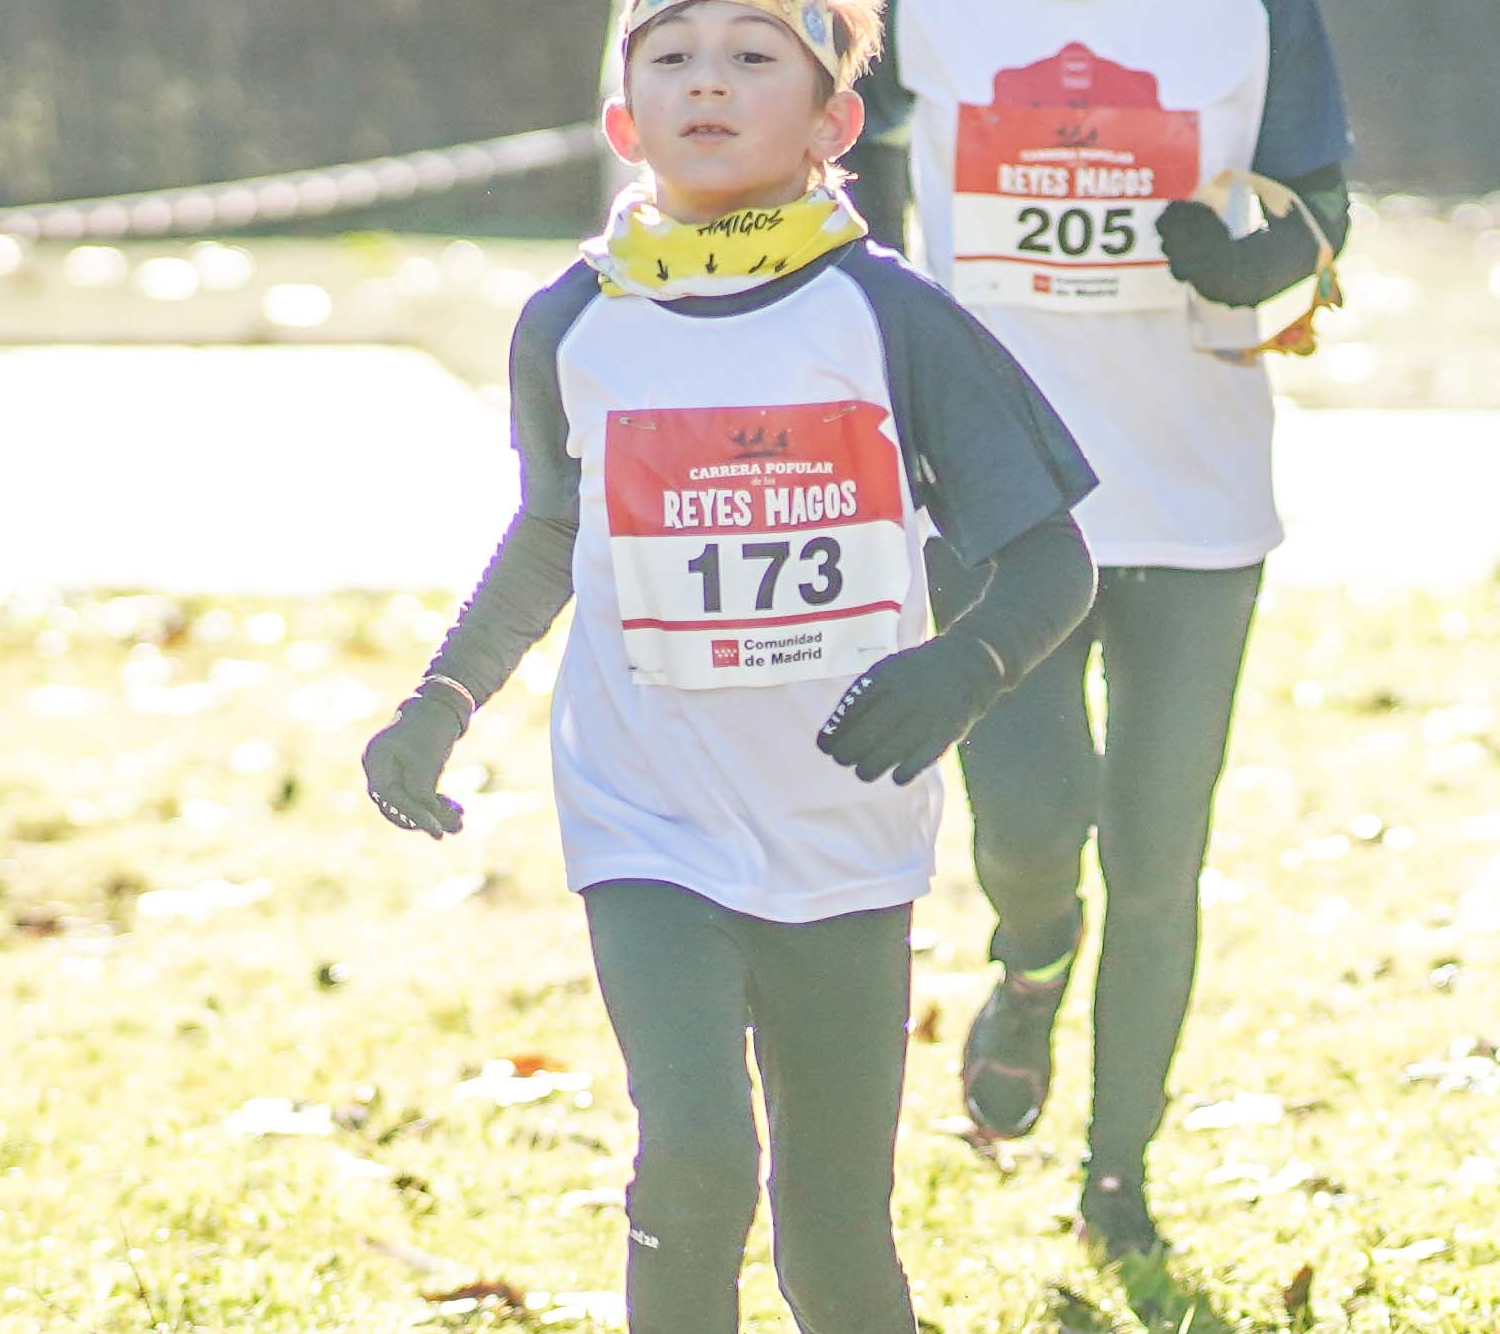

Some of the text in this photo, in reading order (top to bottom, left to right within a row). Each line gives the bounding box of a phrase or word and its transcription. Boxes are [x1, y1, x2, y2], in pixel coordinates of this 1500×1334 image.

[998, 163, 1154, 197] REYES MAGOS
[697, 208, 784, 238] AMIGOS
[1017, 207, 1135, 256] 205
[689, 461, 834, 480] CARRERA POPULAR
[663, 480, 857, 529] REYES MAGOS
[688, 536, 843, 613] 173
[744, 632, 823, 651] Comunidad
[745, 648, 823, 667] de Madrid
[823, 676, 873, 735] KIPSTA
